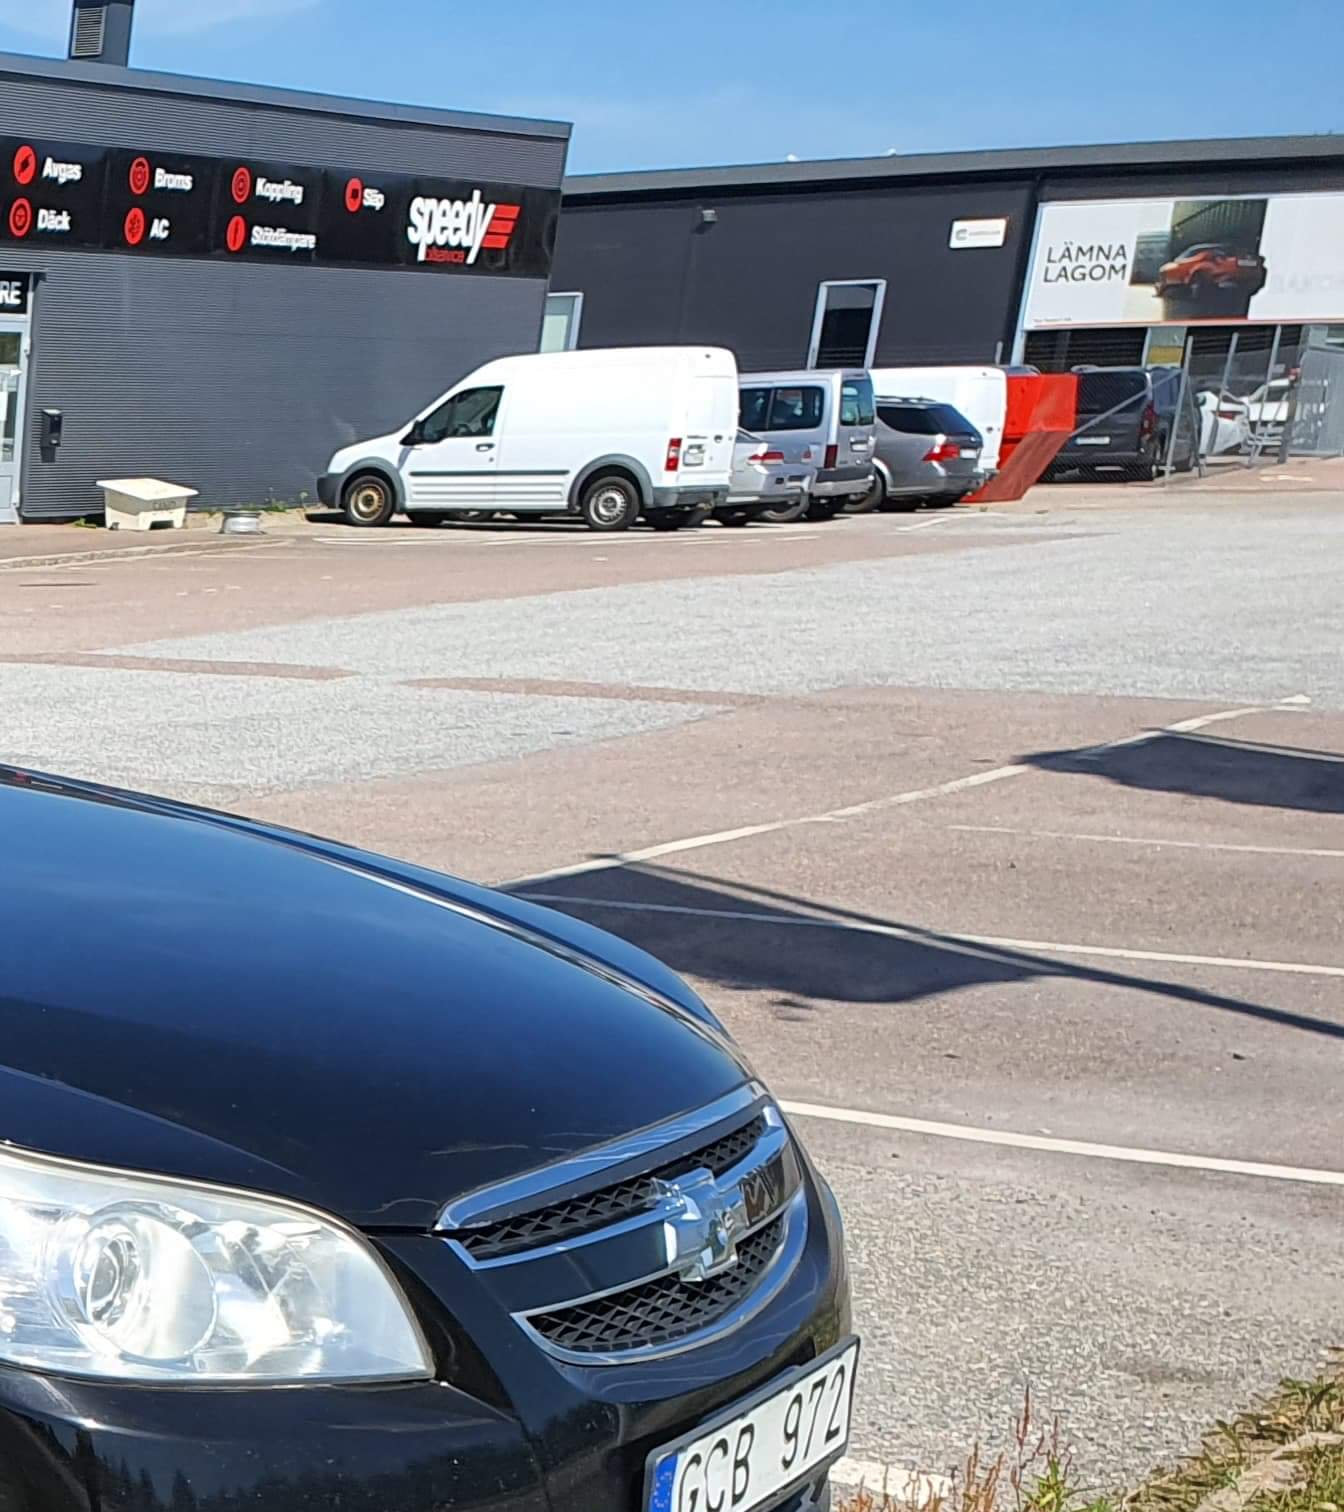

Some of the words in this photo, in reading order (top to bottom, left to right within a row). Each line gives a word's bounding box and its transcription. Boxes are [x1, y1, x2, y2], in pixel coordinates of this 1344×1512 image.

[42, 157, 82, 184] Avgas
[154, 167, 193, 191] Broms
[37, 208, 71, 231] Däck
[149, 218, 170, 239] AC
[407, 190, 497, 265] speedy
[1046, 241, 1128, 264] LÄMNA
[1043, 264, 1127, 283] LAGOM
[780, 1363, 846, 1473] 972
